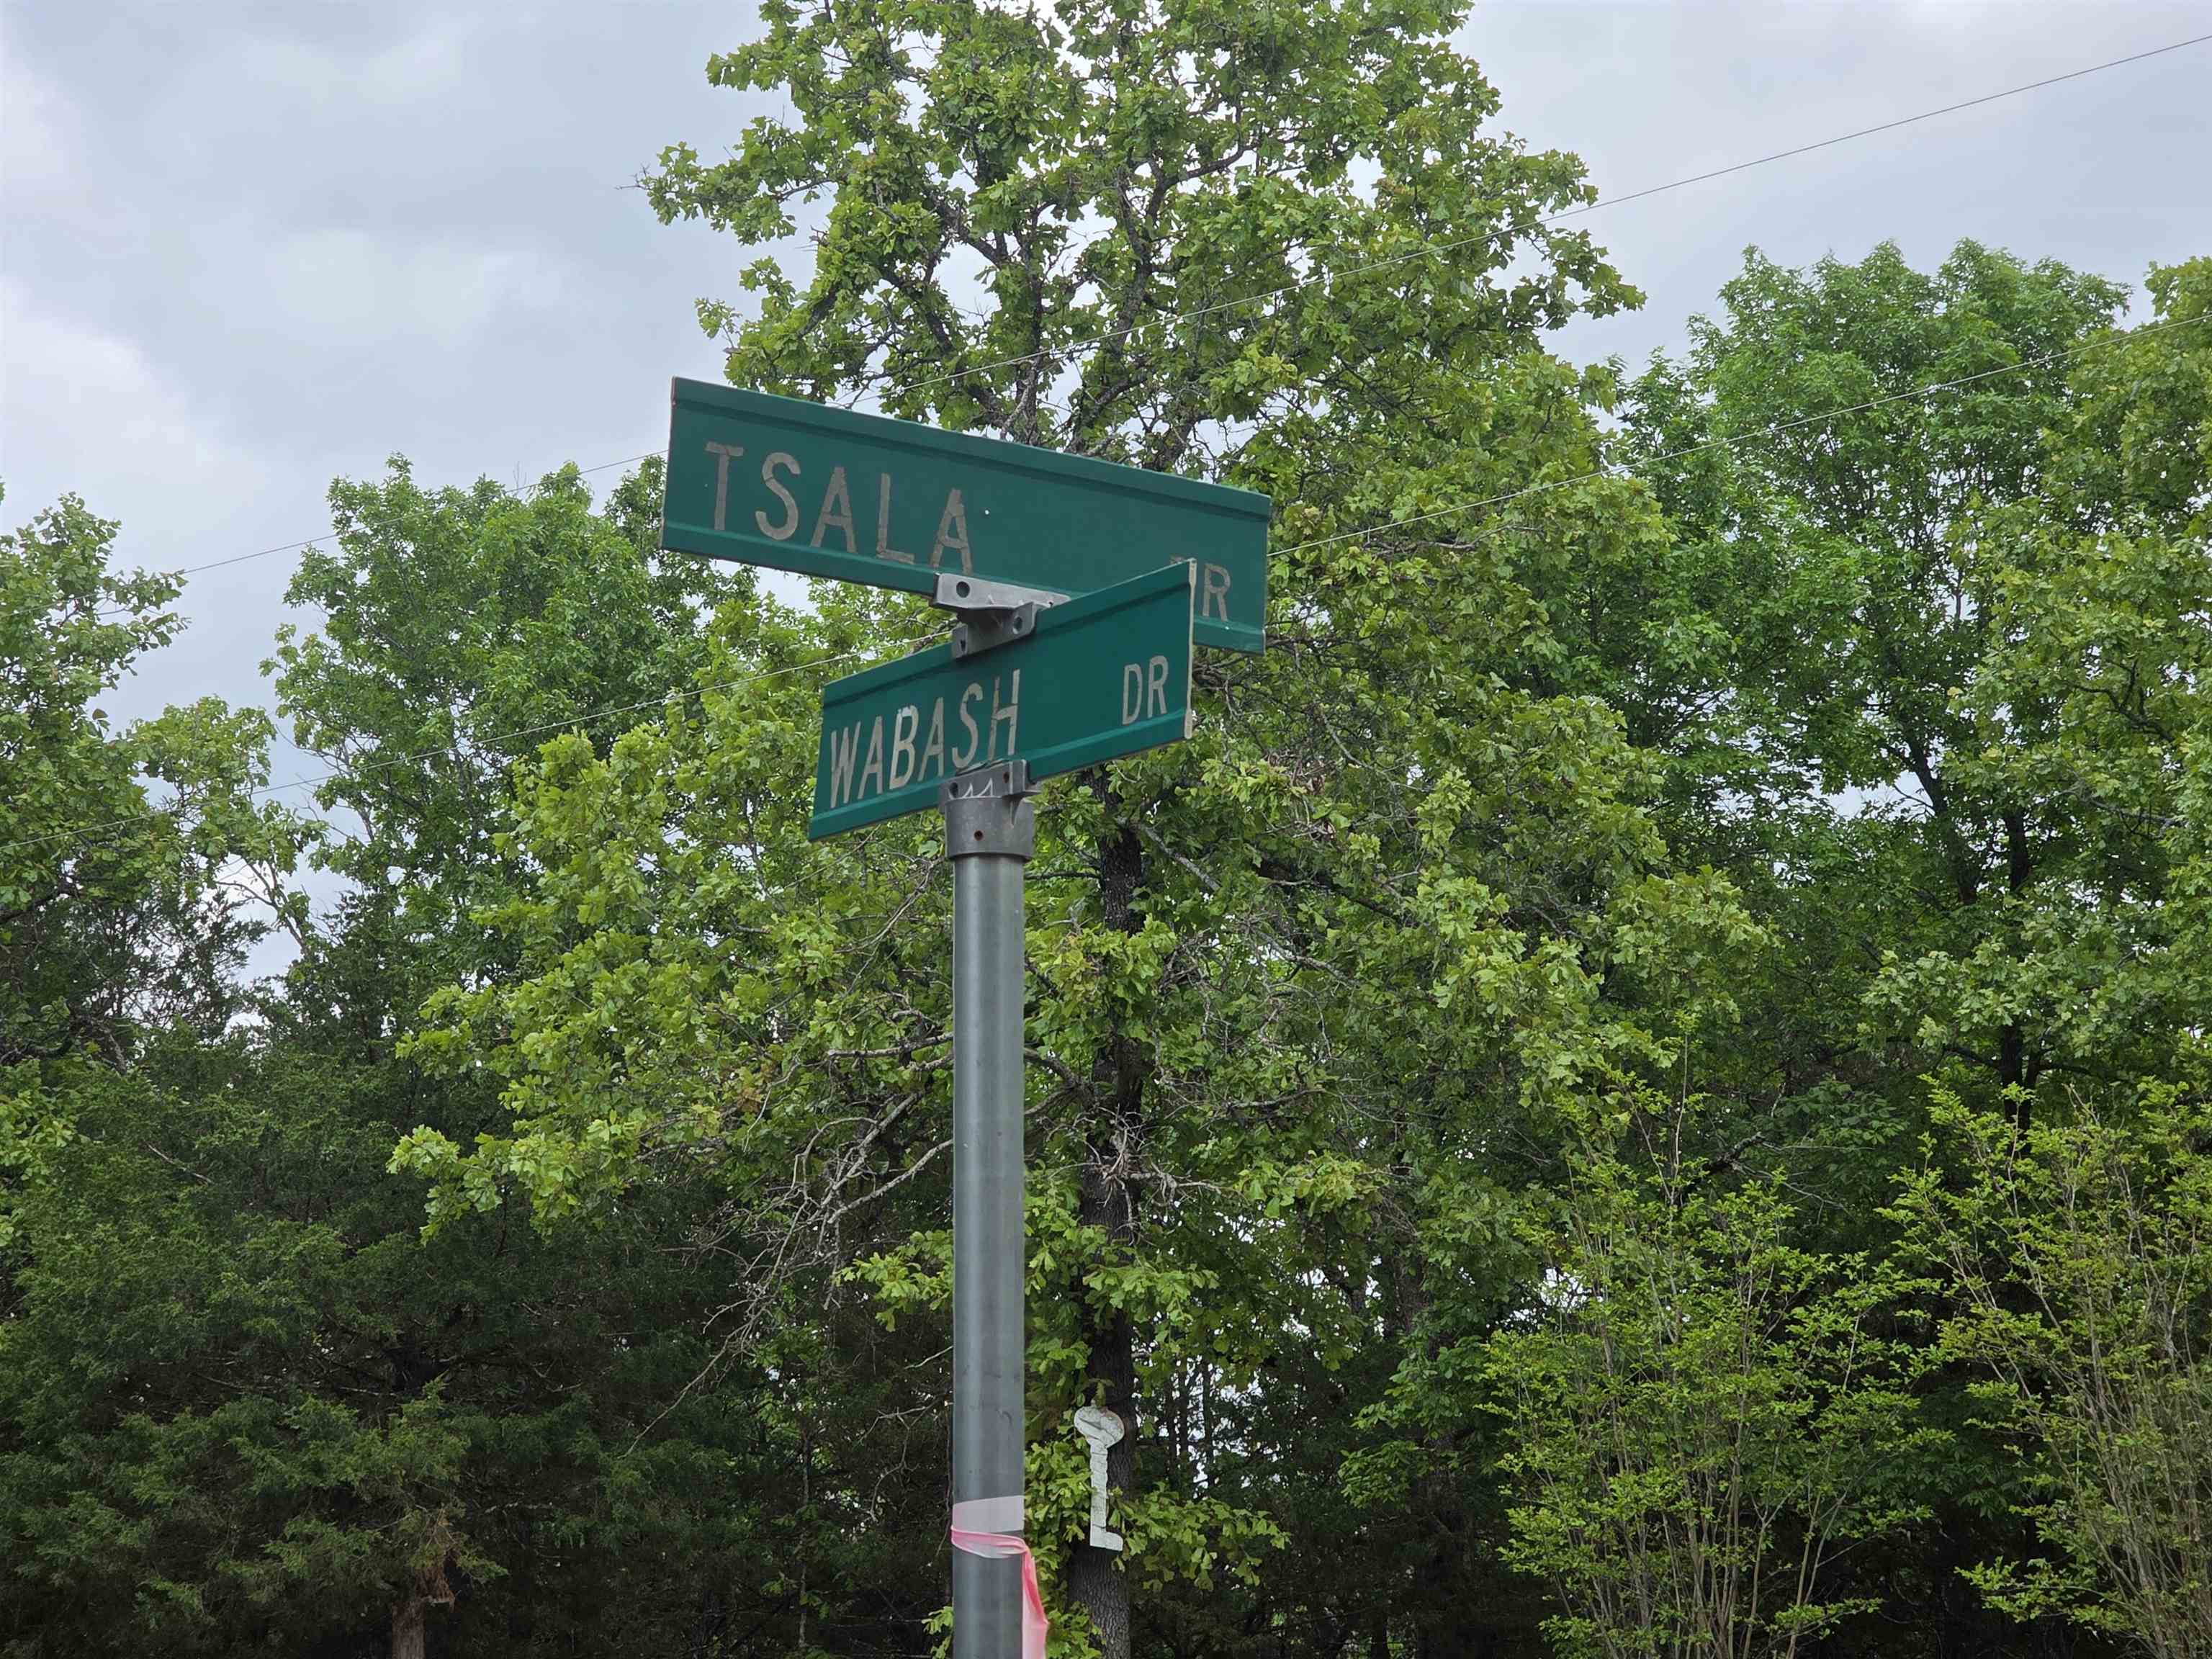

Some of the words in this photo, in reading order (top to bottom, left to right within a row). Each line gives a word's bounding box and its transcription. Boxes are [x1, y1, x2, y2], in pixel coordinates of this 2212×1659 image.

[704, 441, 972, 576] TSALA
[1169, 555, 1231, 622] R
[830, 668, 1021, 809] WABASH
[1122, 655, 1169, 726] DR
